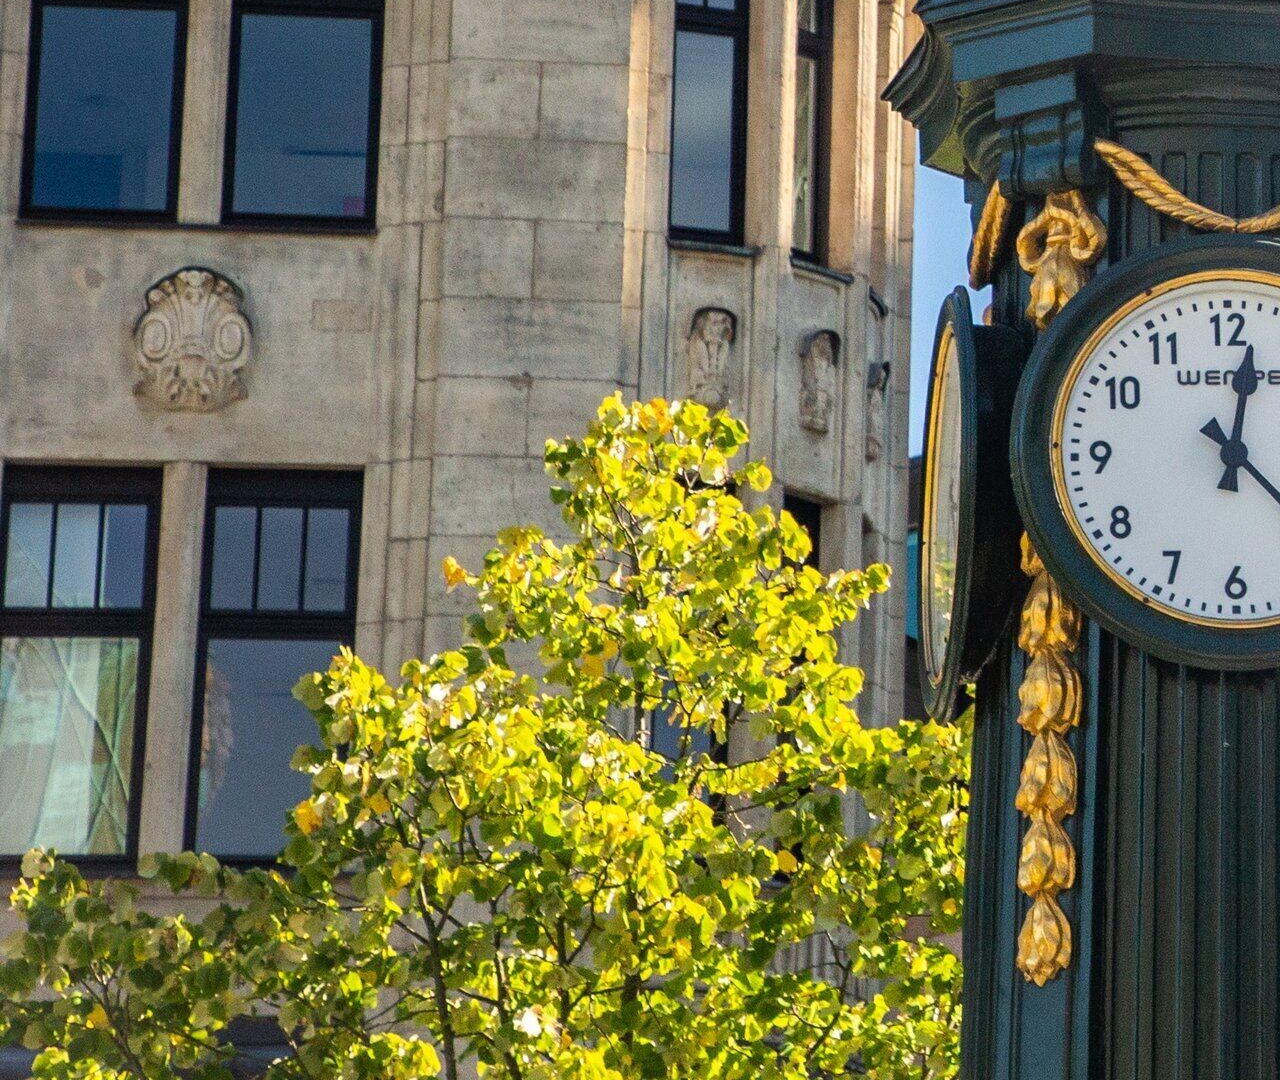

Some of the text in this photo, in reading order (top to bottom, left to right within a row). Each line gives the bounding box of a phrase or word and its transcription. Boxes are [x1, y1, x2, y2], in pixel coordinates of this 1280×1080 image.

[1210, 313, 1246, 346] 12
[1149, 332, 1177, 364] 11
[1105, 376, 1140, 409] 10
[1090, 441, 1112, 474] 9
[1110, 506, 1131, 539] 8
[1163, 551, 1181, 584] 7
[1225, 566, 1247, 599] 6
